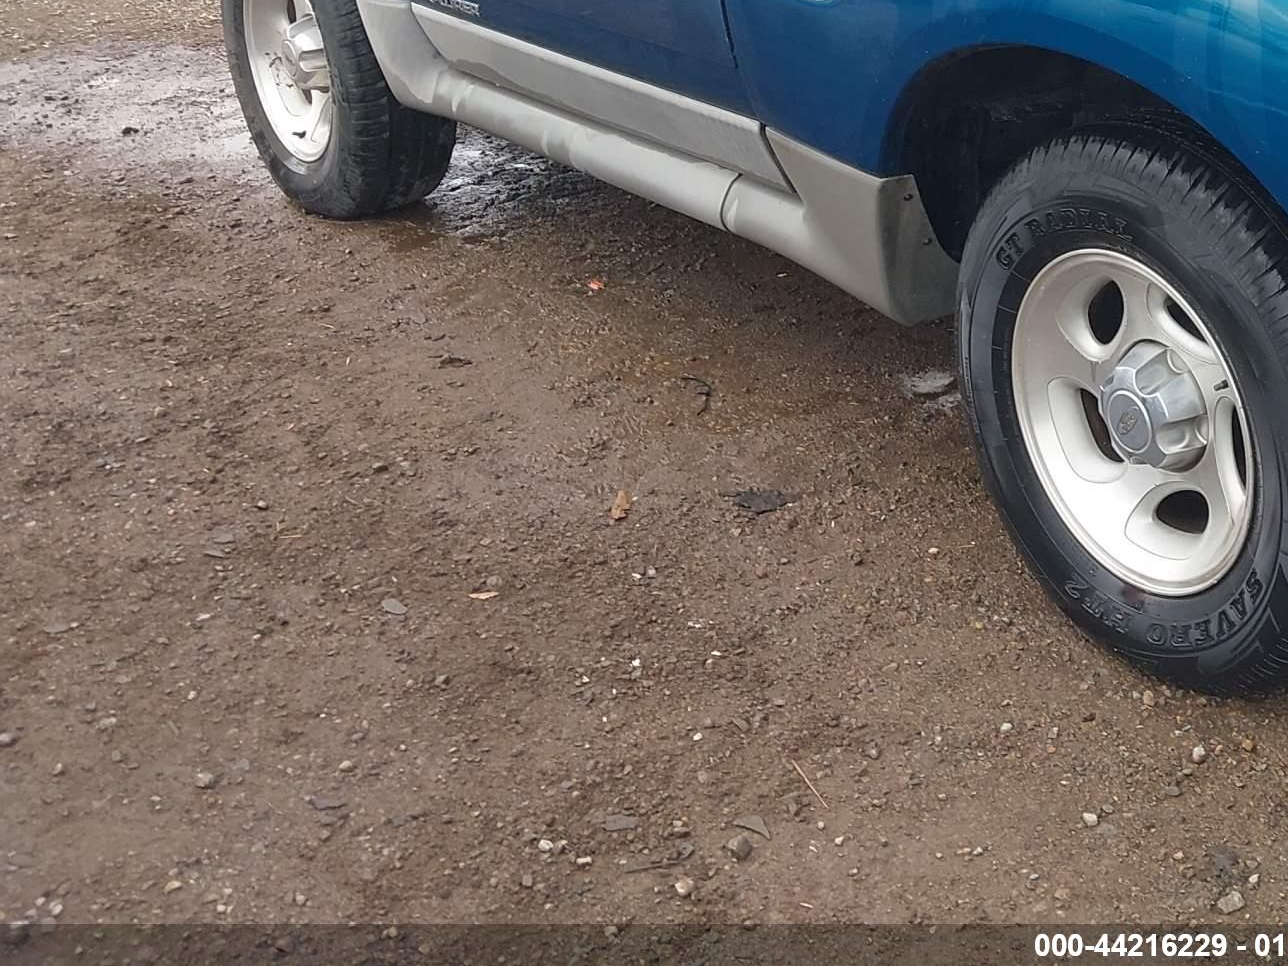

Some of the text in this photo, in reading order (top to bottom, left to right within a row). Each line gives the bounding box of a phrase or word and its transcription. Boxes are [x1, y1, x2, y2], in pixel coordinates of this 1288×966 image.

[996, 207, 1134, 272] GT RADIAL
[1146, 567, 1264, 647] SAVERO
